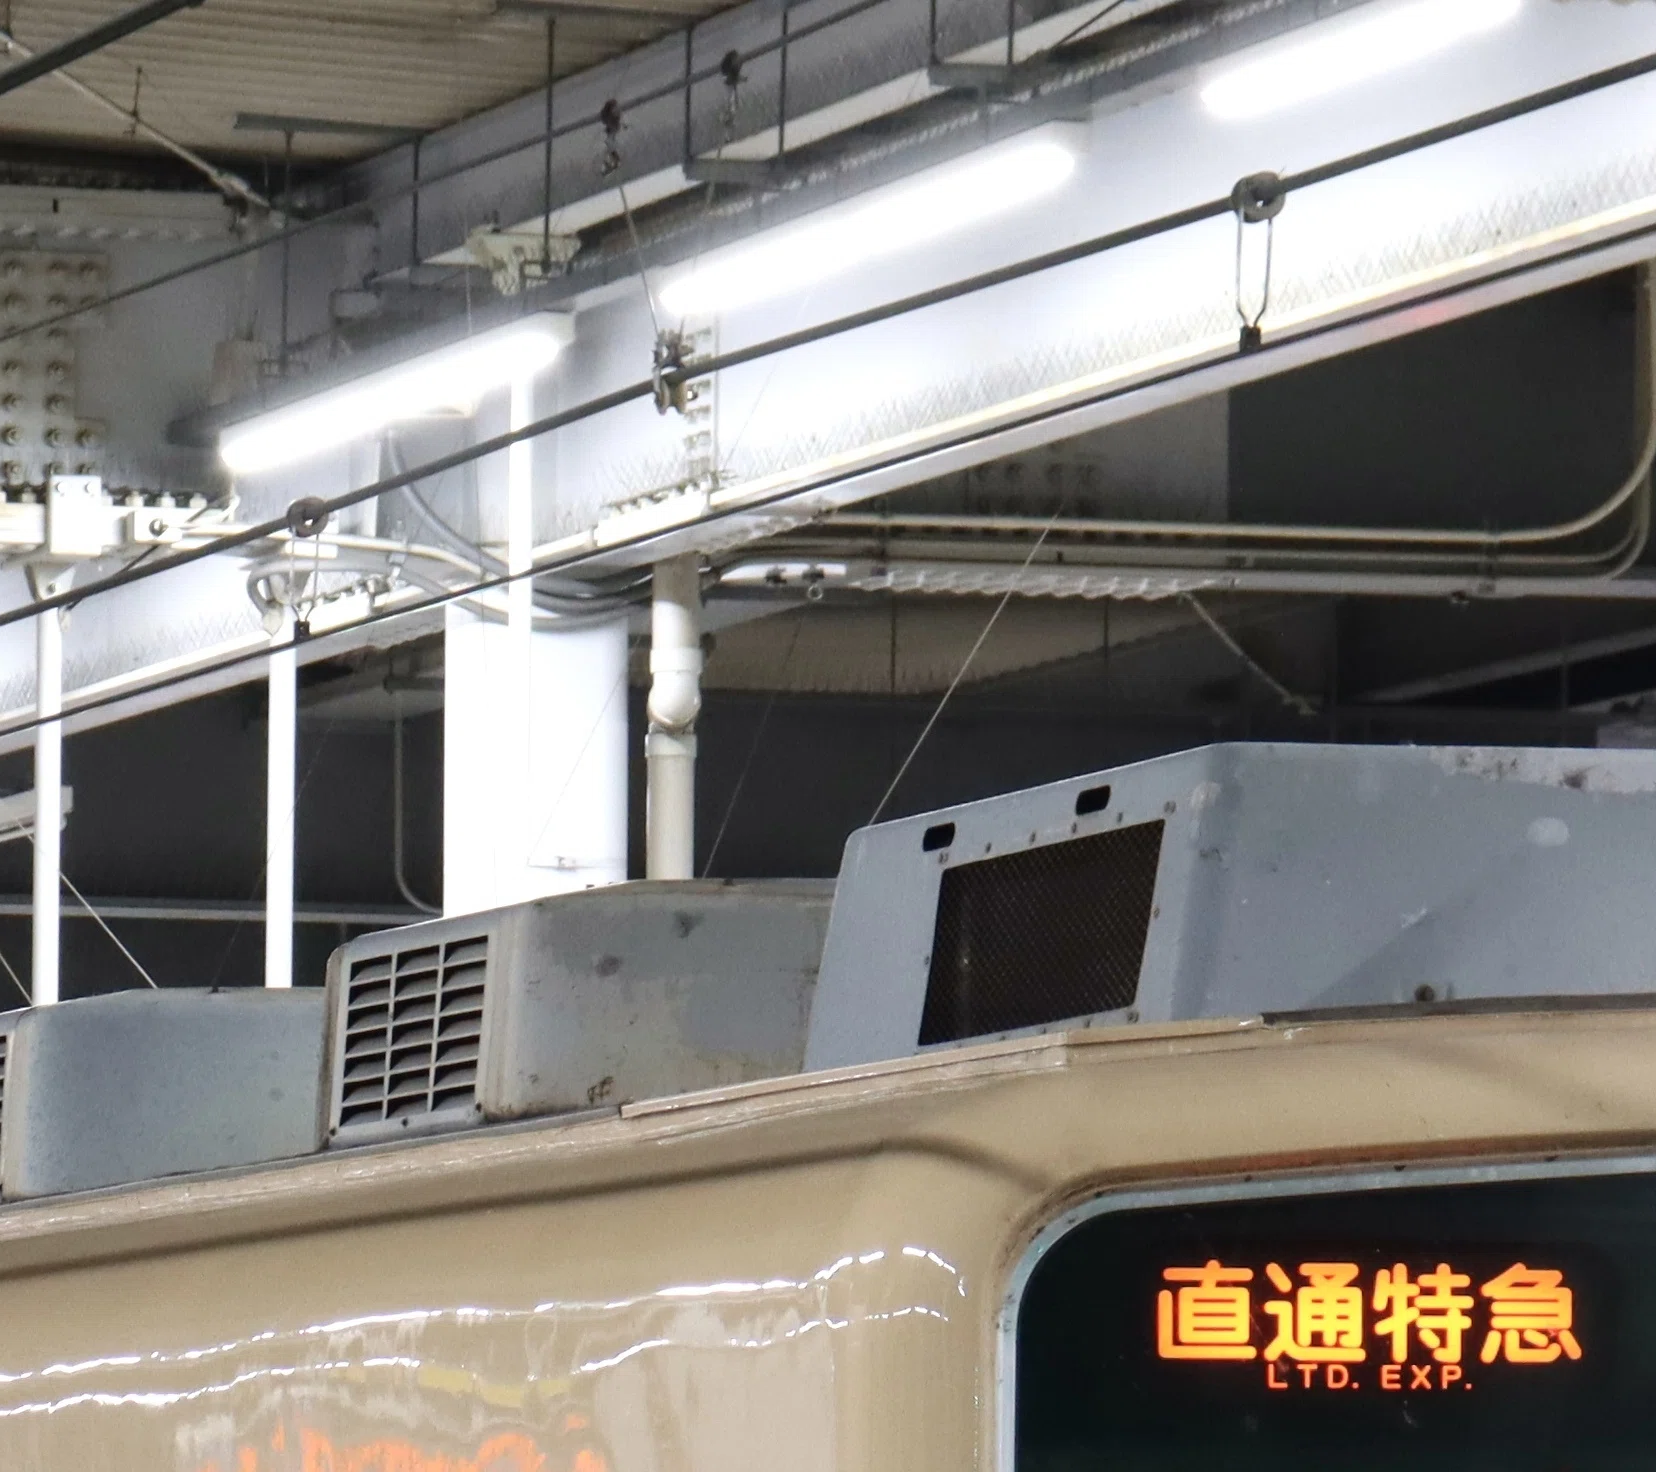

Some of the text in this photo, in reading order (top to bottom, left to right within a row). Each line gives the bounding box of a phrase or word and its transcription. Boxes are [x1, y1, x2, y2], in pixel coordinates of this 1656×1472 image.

[1155, 1258, 1583, 1366] 直通特急
[1266, 1363, 1474, 1392] LTD. EXP.
